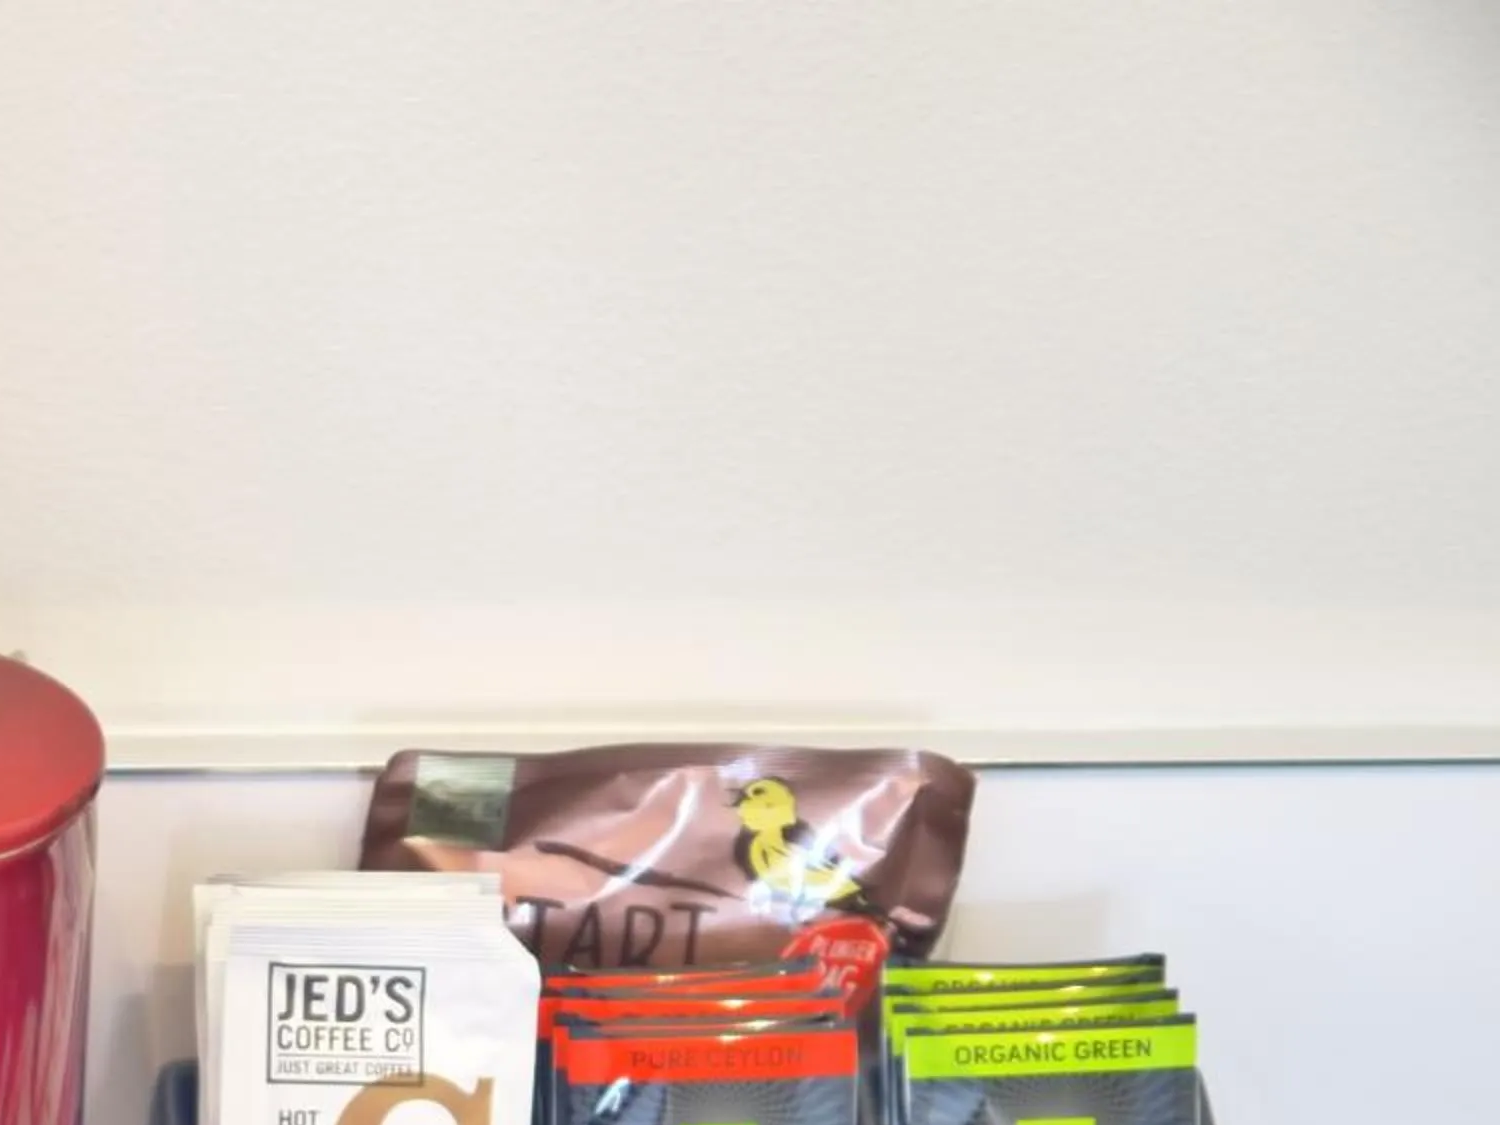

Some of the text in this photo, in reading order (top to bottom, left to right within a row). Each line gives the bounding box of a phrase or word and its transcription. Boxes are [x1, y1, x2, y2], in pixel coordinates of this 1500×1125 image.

[503, 896, 717, 966] TART
[276, 973, 414, 1024] JED'S
[276, 1024, 372, 1051] COFFEE
[631, 1046, 801, 1070] PURE CEYLON
[954, 1039, 1152, 1065] ORGANIC GREEN
[277, 1059, 413, 1078] JUST GREAT COFFEE
